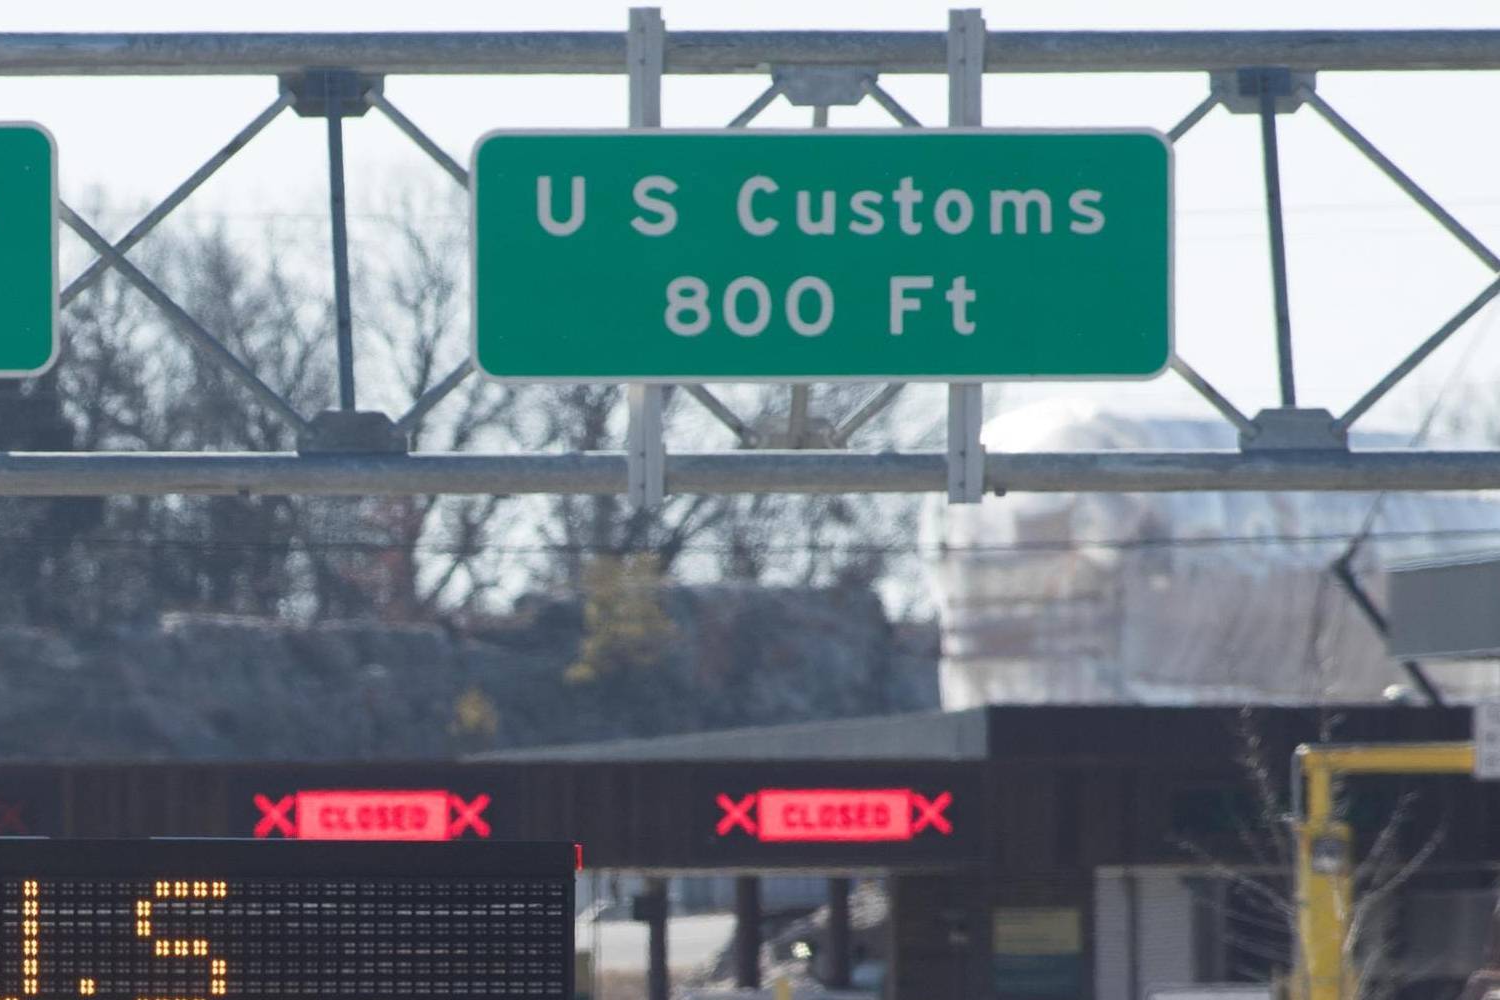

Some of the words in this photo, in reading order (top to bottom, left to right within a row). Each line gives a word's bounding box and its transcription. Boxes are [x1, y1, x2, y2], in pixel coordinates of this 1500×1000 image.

[536, 175, 586, 236] U
[630, 175, 679, 236] S
[736, 175, 1106, 236] Customs
[664, 275, 835, 337] 800
[889, 275, 977, 336] Ft
[318, 804, 429, 832] CLOSED
[781, 803, 892, 830] CLOSED
